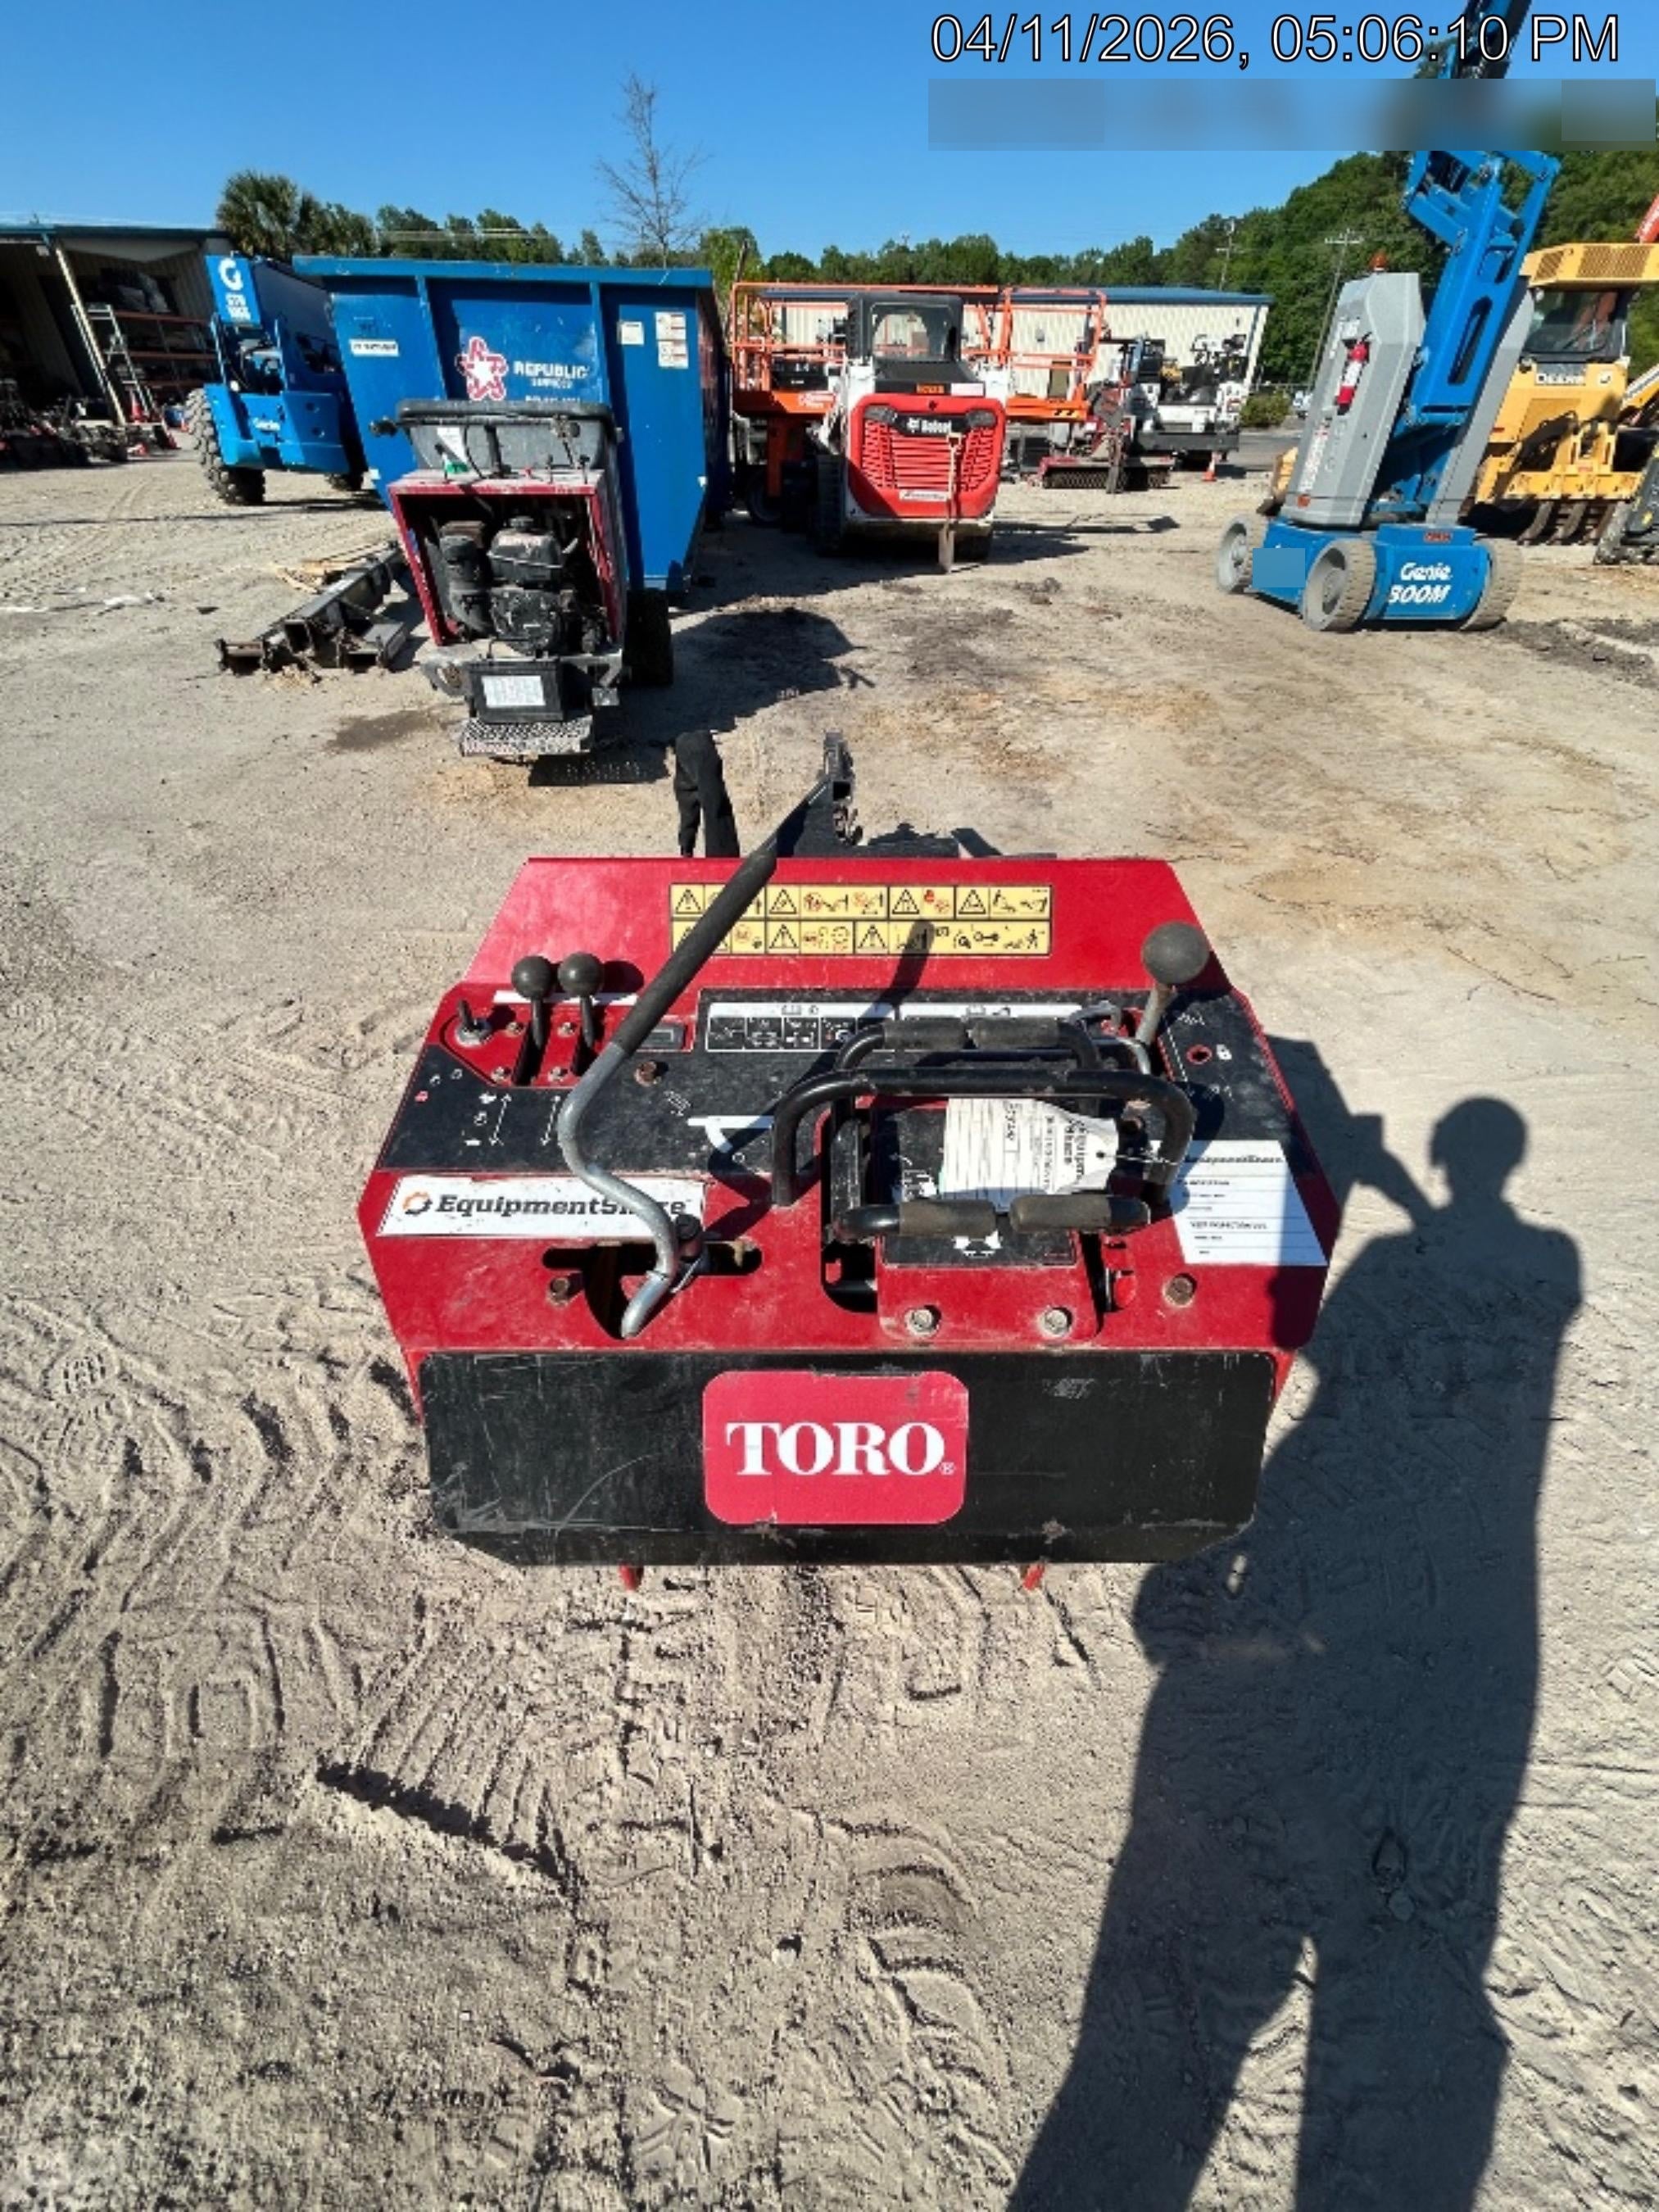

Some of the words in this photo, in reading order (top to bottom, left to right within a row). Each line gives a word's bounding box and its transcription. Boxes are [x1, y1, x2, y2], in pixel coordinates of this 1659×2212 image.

[513, 360, 589, 379] REPUBLIC
[1400, 562, 1452, 581] Genie
[435, 1194, 687, 1217] EquipmentSe
